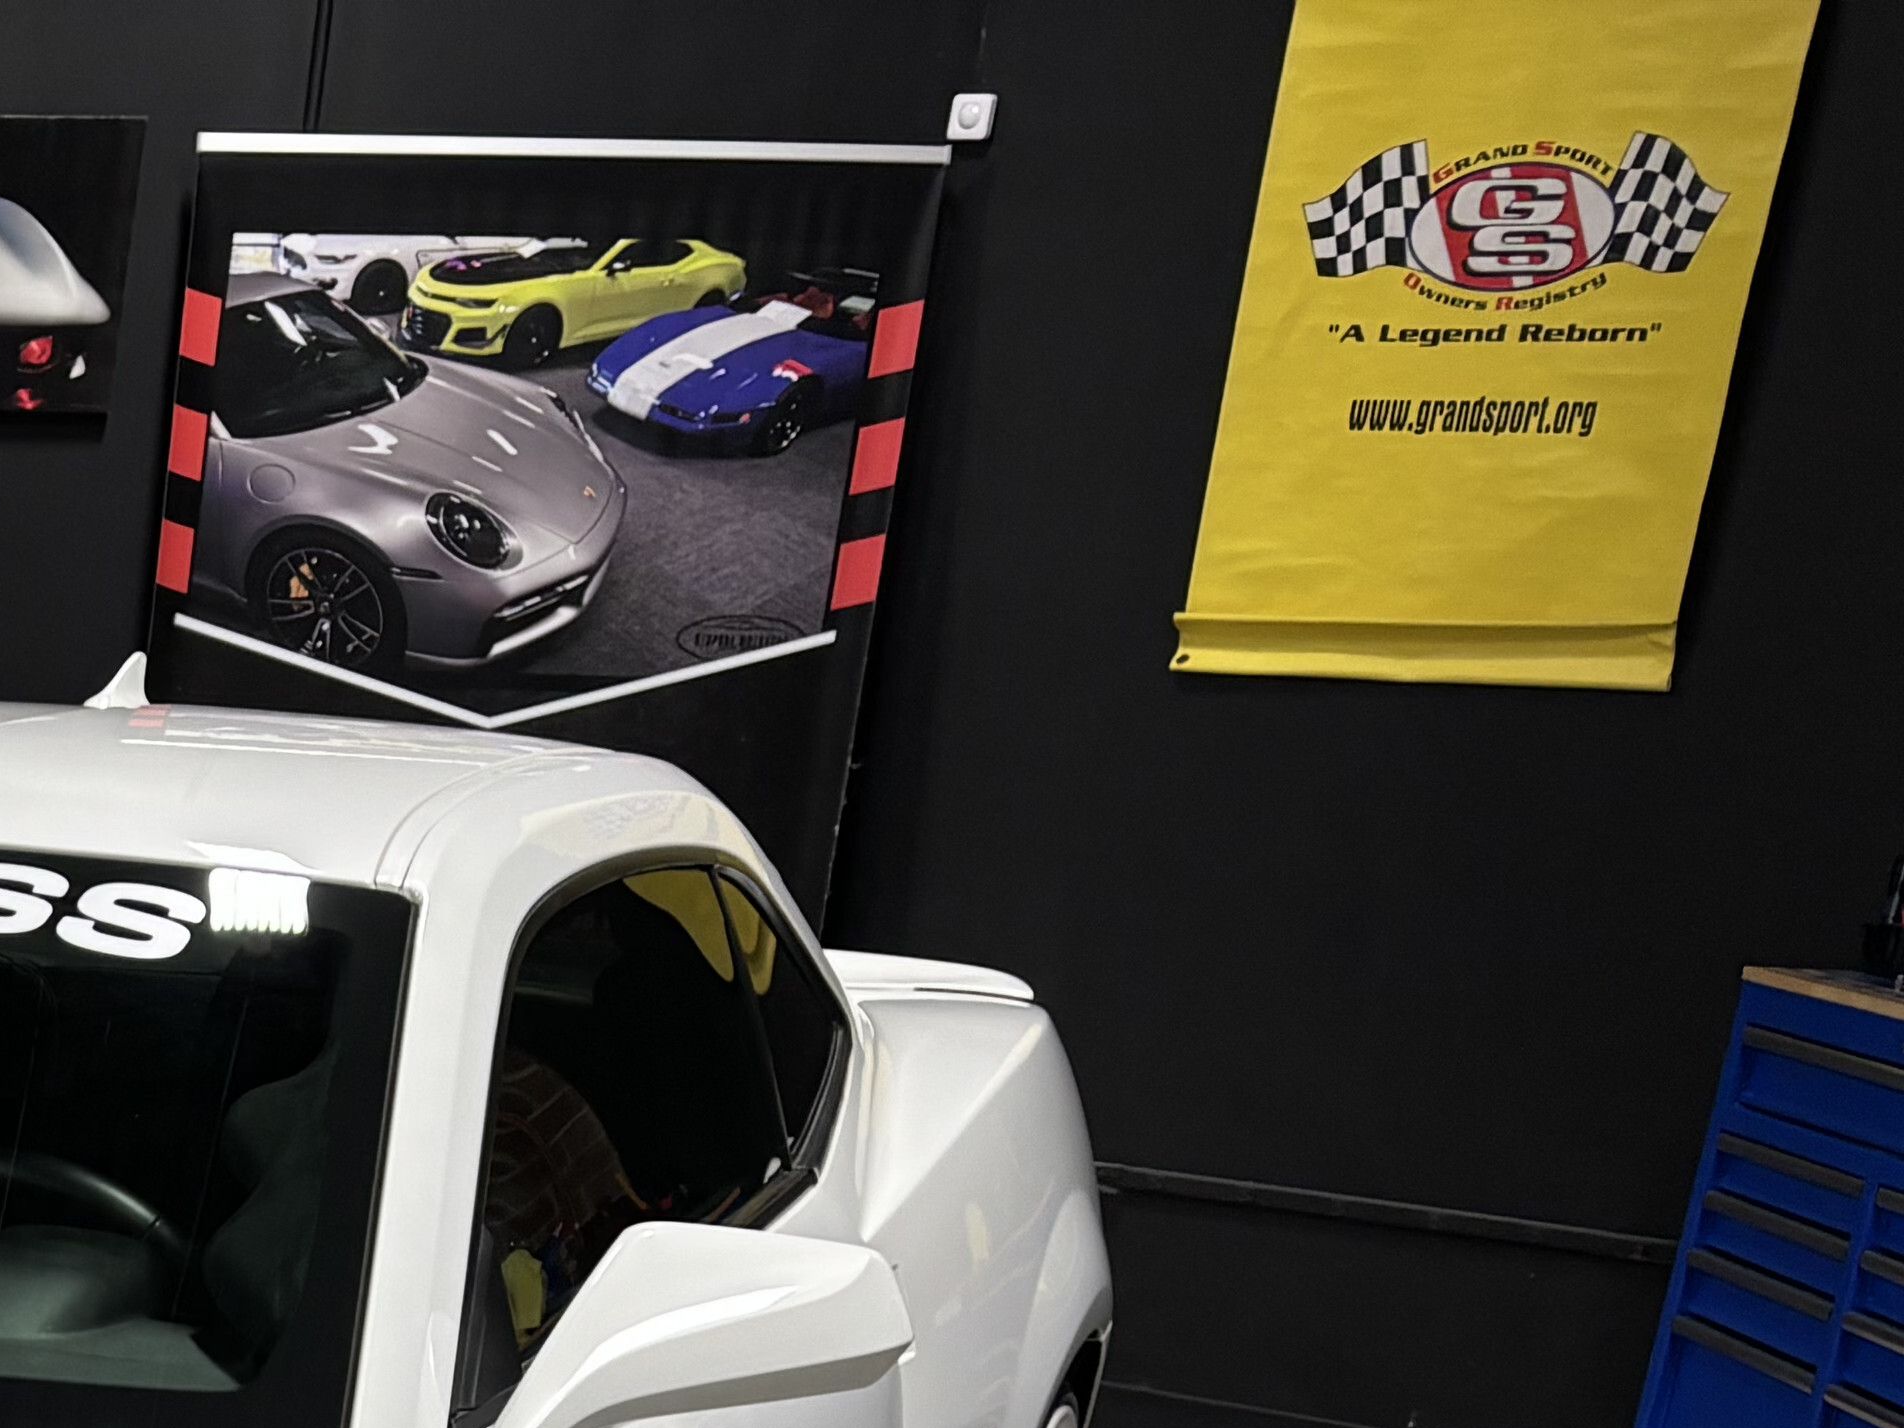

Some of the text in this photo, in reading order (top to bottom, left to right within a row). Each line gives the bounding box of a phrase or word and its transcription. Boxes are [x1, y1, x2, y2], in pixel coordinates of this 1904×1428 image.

[1432, 140, 1614, 184] GRAND SPORT
[1403, 272, 1608, 311] Owners Registry
[1328, 322, 1662, 347] "A Legend Reborn"
[1348, 395, 1599, 437] www.grandsport.org
